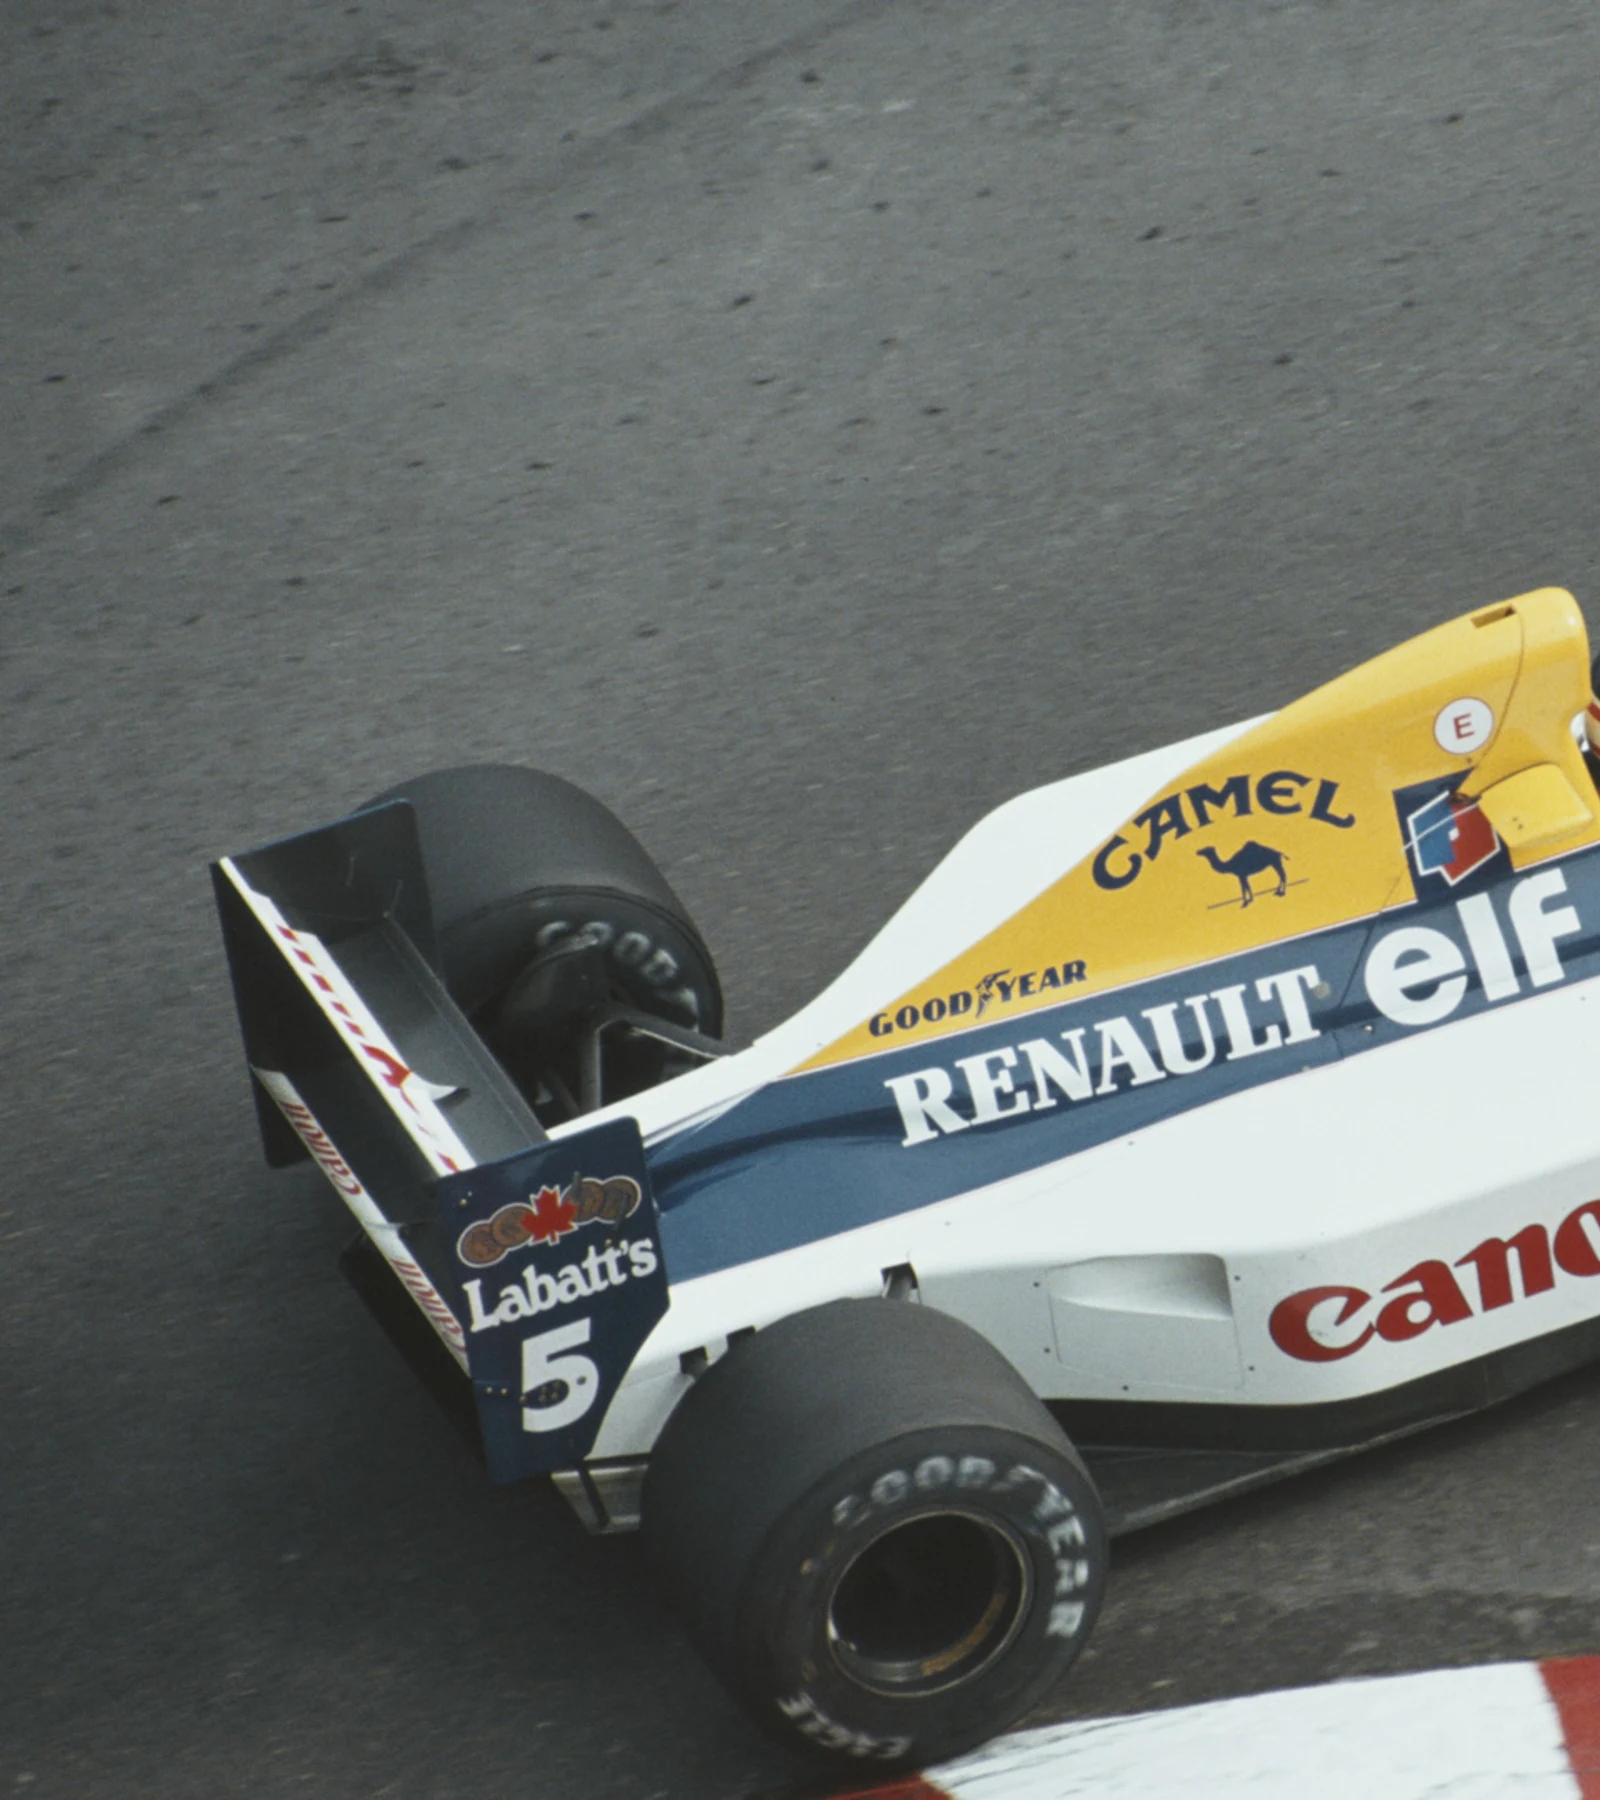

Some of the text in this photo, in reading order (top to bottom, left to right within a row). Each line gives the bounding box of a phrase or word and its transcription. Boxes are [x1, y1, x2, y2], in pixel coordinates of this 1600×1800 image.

[1453, 712, 1476, 740] E
[1090, 769, 1357, 891] CAMEL
[1363, 868, 1583, 1026] elf
[883, 964, 1322, 1148] RENAULT
[462, 1237, 658, 1333] Labatt's
[521, 1316, 600, 1434] 5
